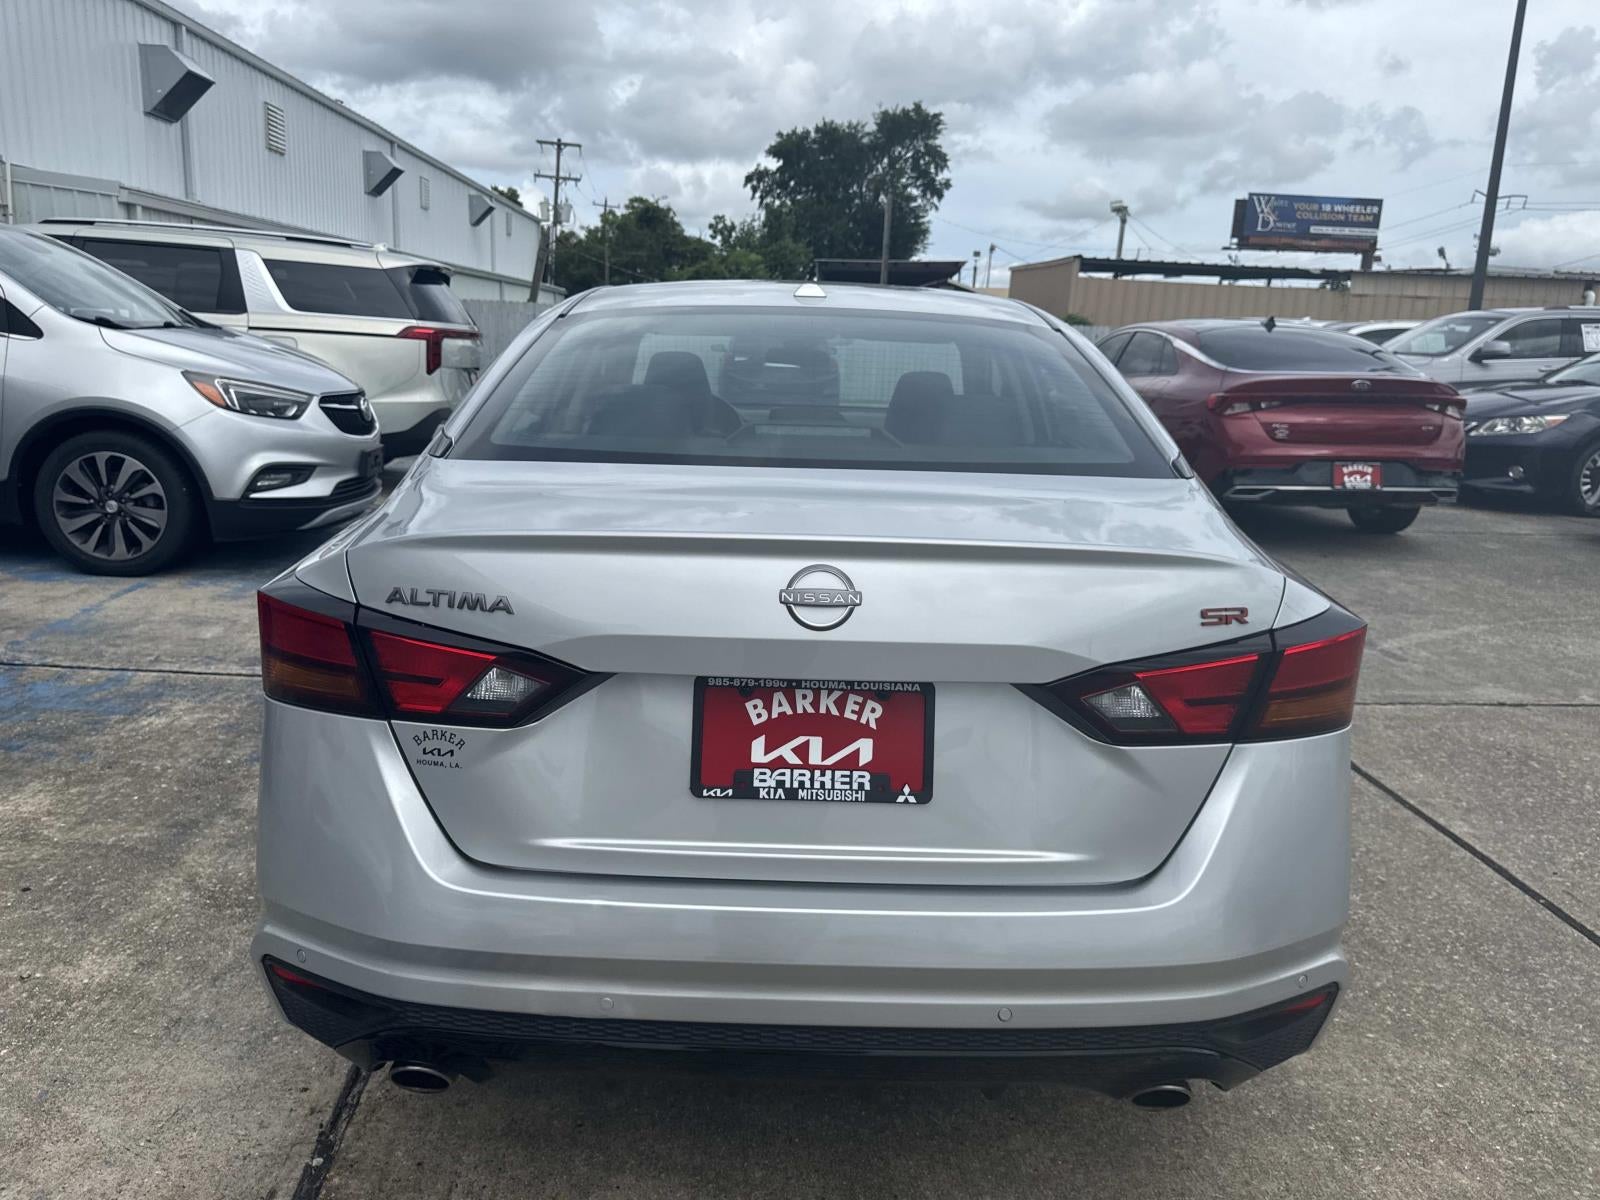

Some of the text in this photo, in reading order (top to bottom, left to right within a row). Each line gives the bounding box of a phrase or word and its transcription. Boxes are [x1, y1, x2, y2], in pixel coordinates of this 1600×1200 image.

[1293, 202, 1320, 211] YOUR
[1333, 204, 1379, 214] WHEELER
[1296, 211, 1374, 222] COLLISION TEAM
[385, 586, 515, 615] ALTIMA
[781, 591, 860, 604] NISSAN
[1200, 607, 1249, 626] SR
[801, 680, 851, 690] HOUMA,
[854, 681, 921, 692] LOUISIANA
[744, 689, 883, 730] BARKER
[412, 729, 466, 750] BARKER
[422, 747, 455, 757] KIA
[750, 734, 874, 767] KIA
[416, 759, 463, 769] HOUMA, LA.
[753, 768, 871, 790] BARKER
[702, 788, 733, 797] KIA
[759, 788, 865, 802] KIA MITSUBISHI
